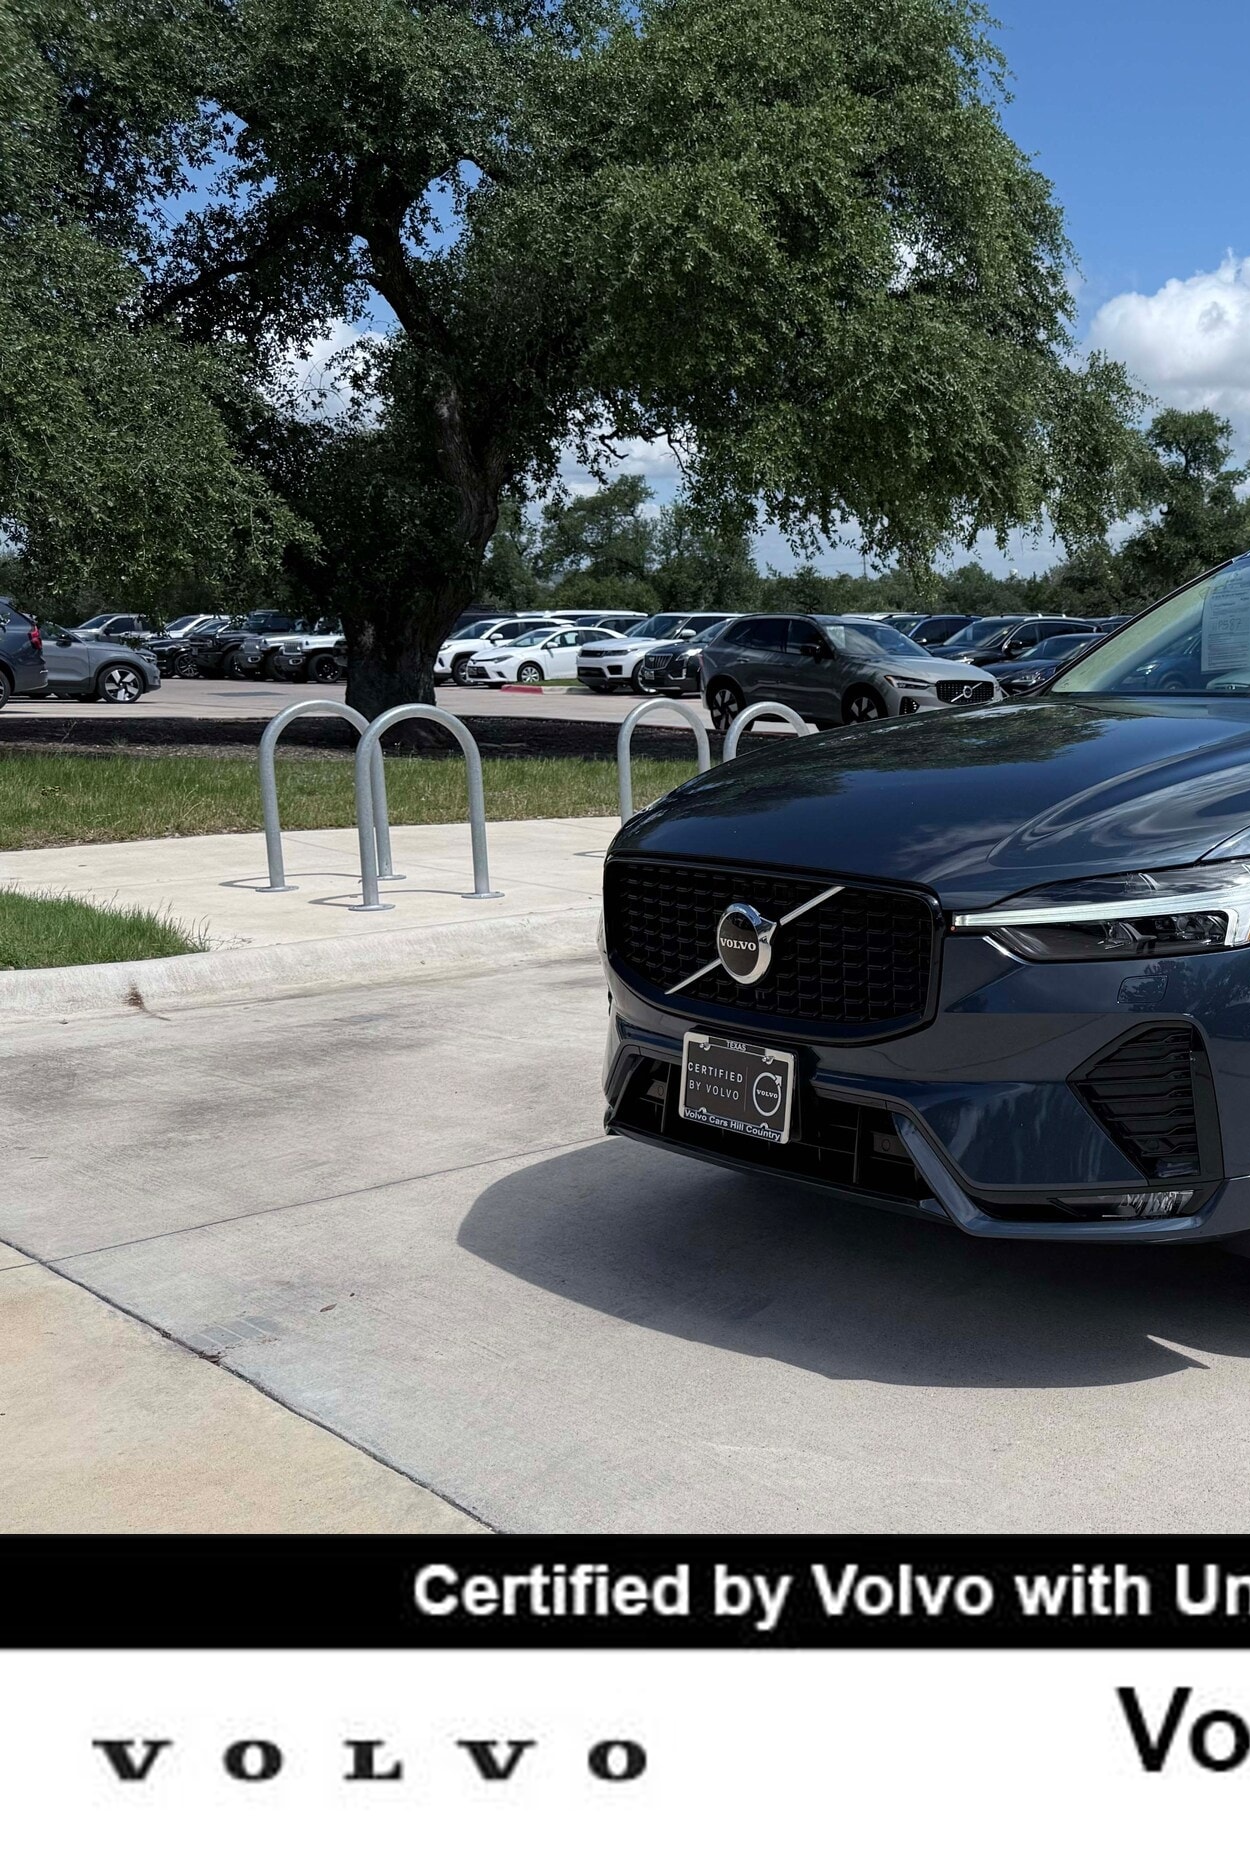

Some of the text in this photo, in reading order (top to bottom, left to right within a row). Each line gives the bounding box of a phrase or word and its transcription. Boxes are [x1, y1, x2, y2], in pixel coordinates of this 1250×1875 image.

[720, 937, 757, 951] VOLVO
[726, 1041, 747, 1052] TEXAS
[687, 1062, 743, 1083] CERTIFIED
[689, 1079, 739, 1100] BY VOLVO
[756, 1089, 778, 1099] VOLVO
[684, 1109, 781, 1141] Volvo Cars Hill Country
